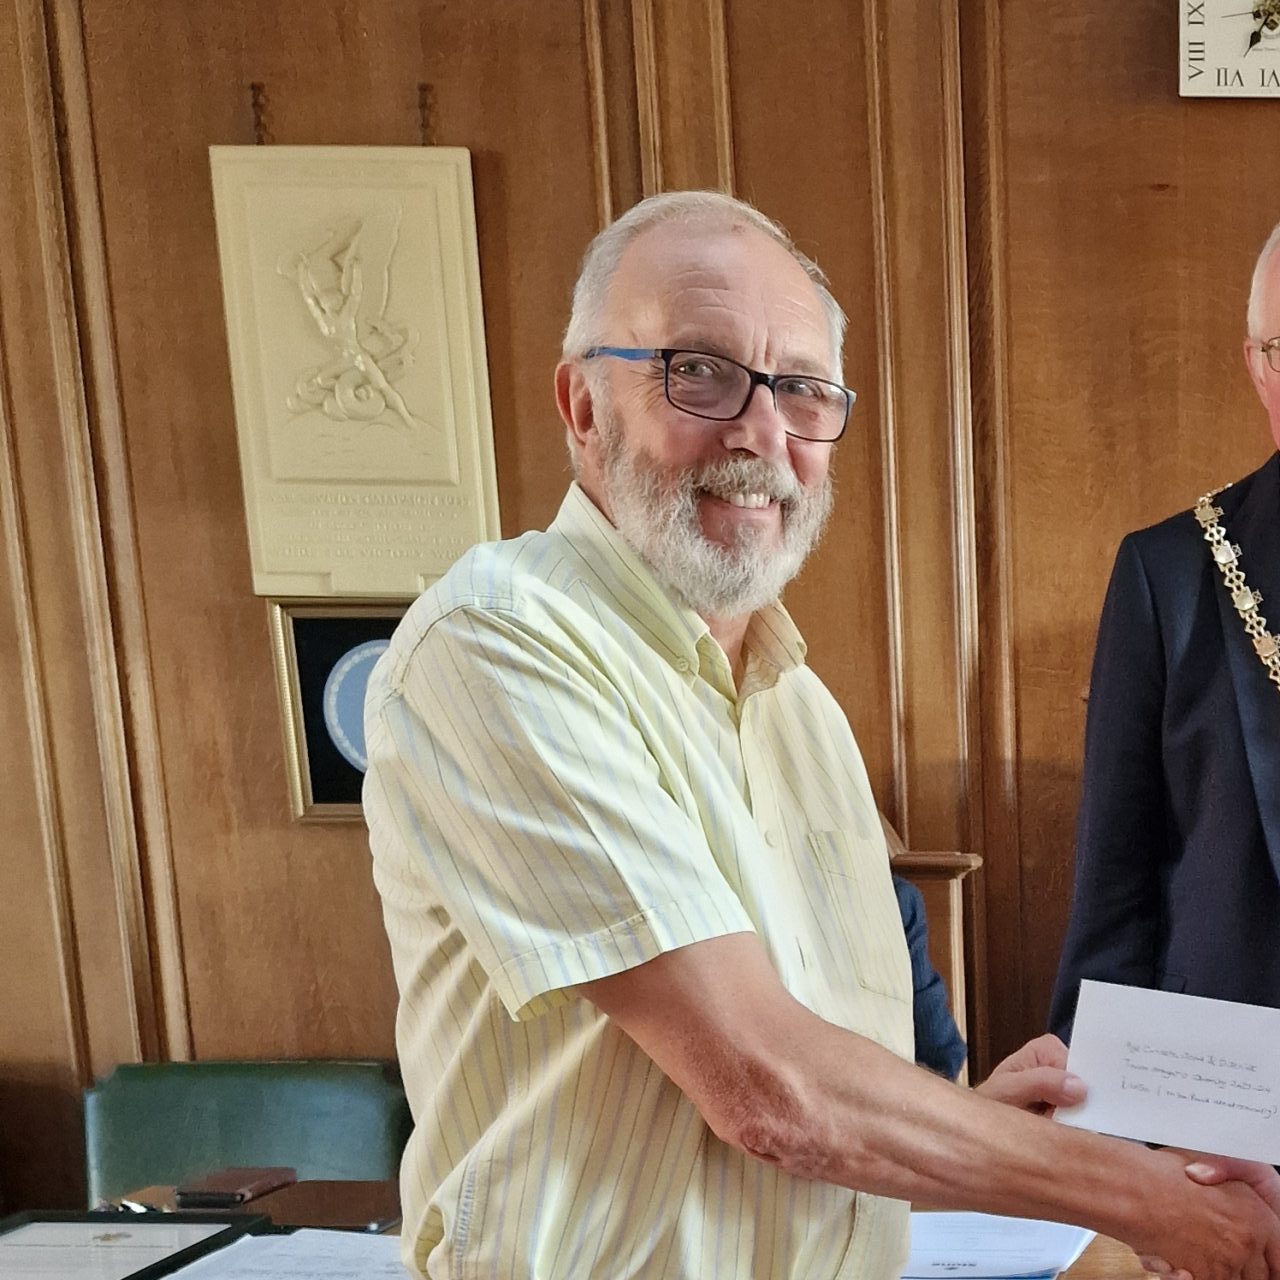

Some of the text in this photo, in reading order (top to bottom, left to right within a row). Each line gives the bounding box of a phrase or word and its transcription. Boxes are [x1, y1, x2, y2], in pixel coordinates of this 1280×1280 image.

[1188, 2, 1205, 26] IX
[1188, 41, 1205, 81] VIII
[1216, 68, 1245, 87] VII
[1260, 68, 1280, 87] VI
